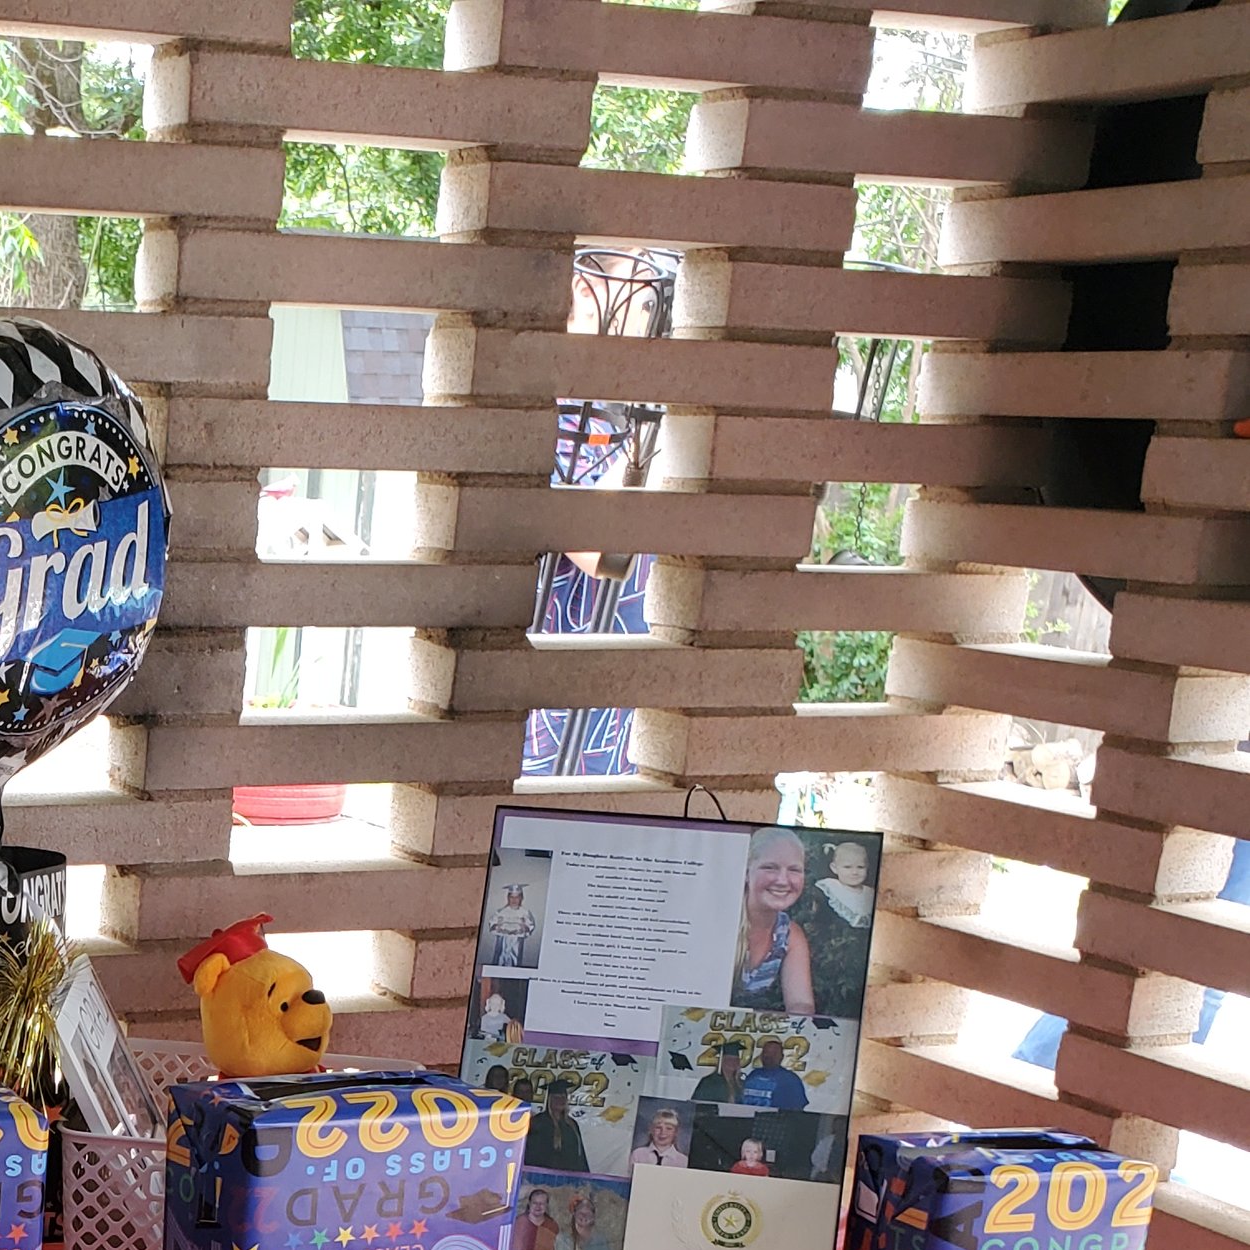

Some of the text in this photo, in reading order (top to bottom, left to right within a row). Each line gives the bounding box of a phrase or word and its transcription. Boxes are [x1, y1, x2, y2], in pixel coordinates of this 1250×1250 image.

[2, 436, 123, 493] CONGRATS
[710, 1012, 789, 1034] CLASS
[512, 1048, 590, 1070] CLASS
[287, 1088, 531, 1158] 2022
[323, 1147, 496, 1182] CLASS OF
[286, 1175, 449, 1226] GRAD
[984, 1160, 1158, 1233] 202
